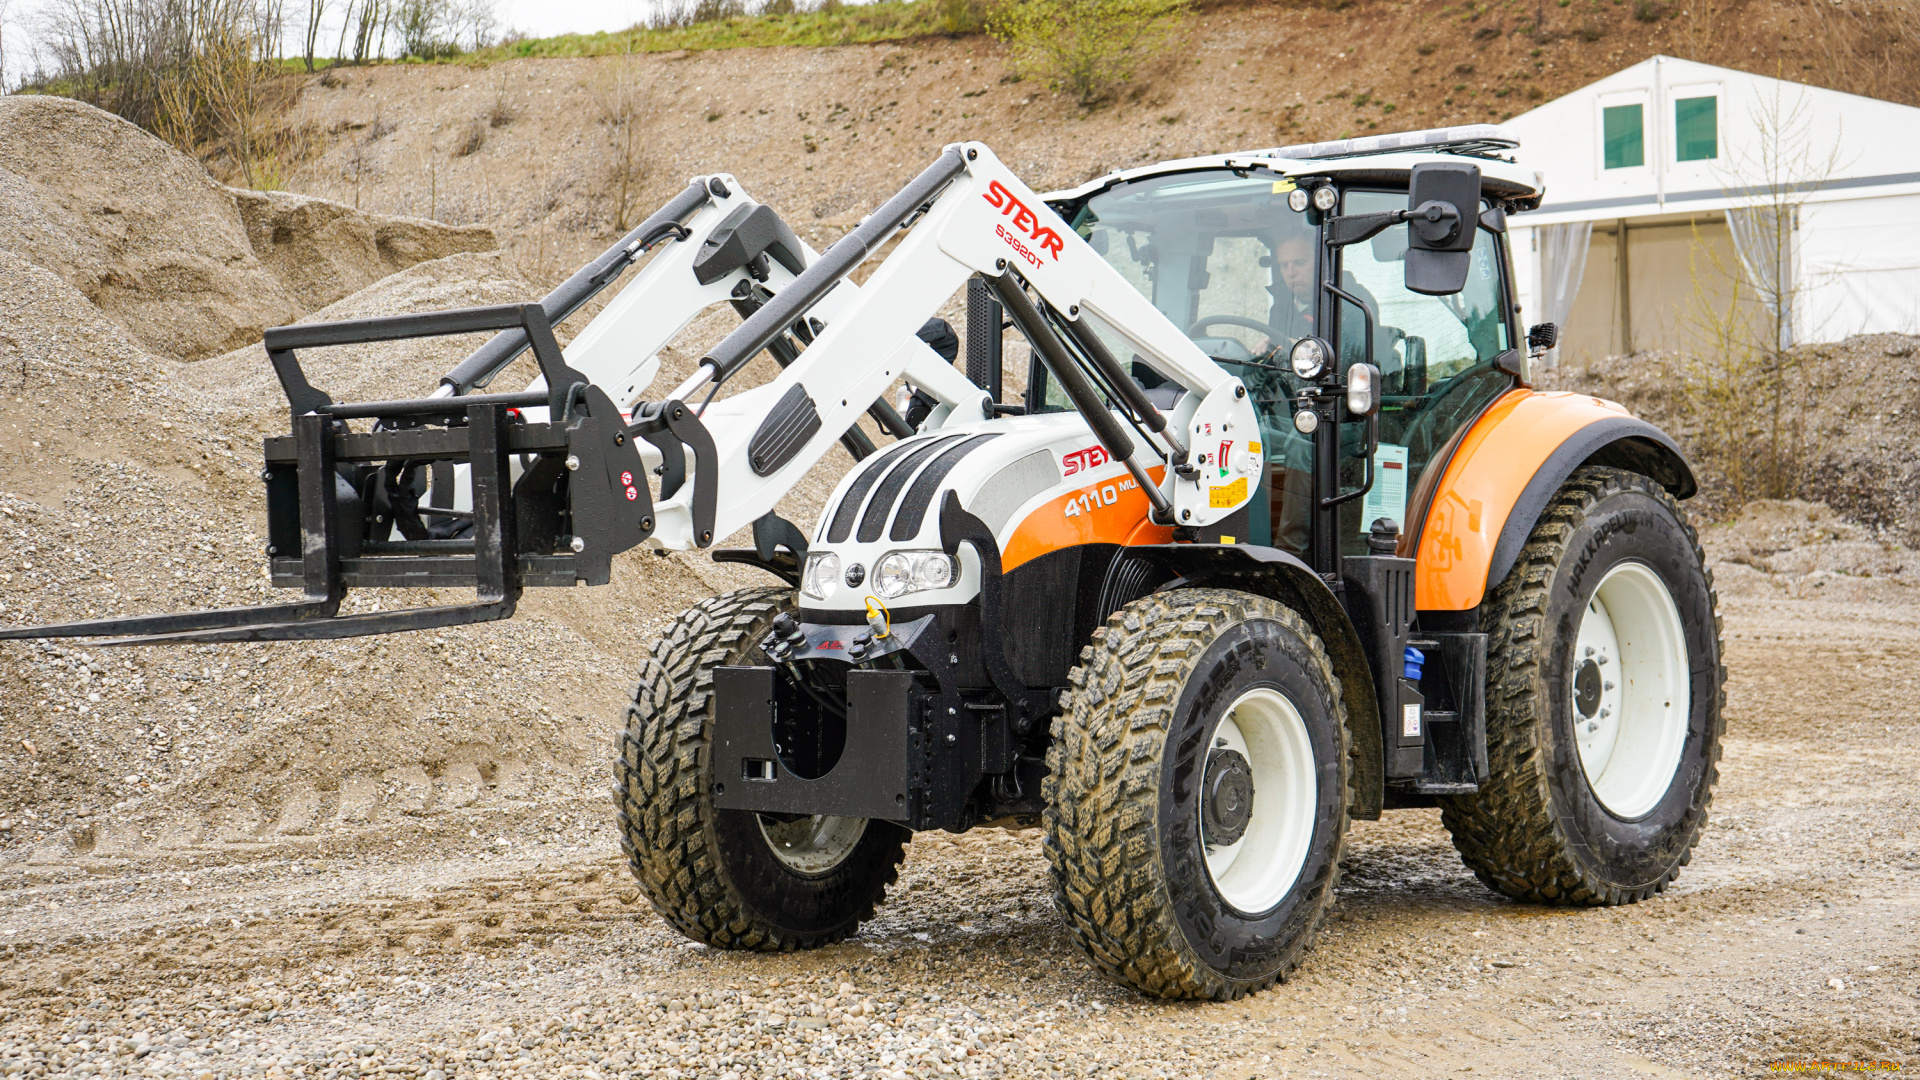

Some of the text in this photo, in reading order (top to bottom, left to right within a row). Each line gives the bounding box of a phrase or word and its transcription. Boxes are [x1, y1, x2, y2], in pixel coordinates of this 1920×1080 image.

[982, 179, 1064, 262] STEYR
[995, 223, 1044, 270] S3920T
[1062, 444, 1109, 477] STEY
[1064, 478, 1140, 518] 4110 MU
